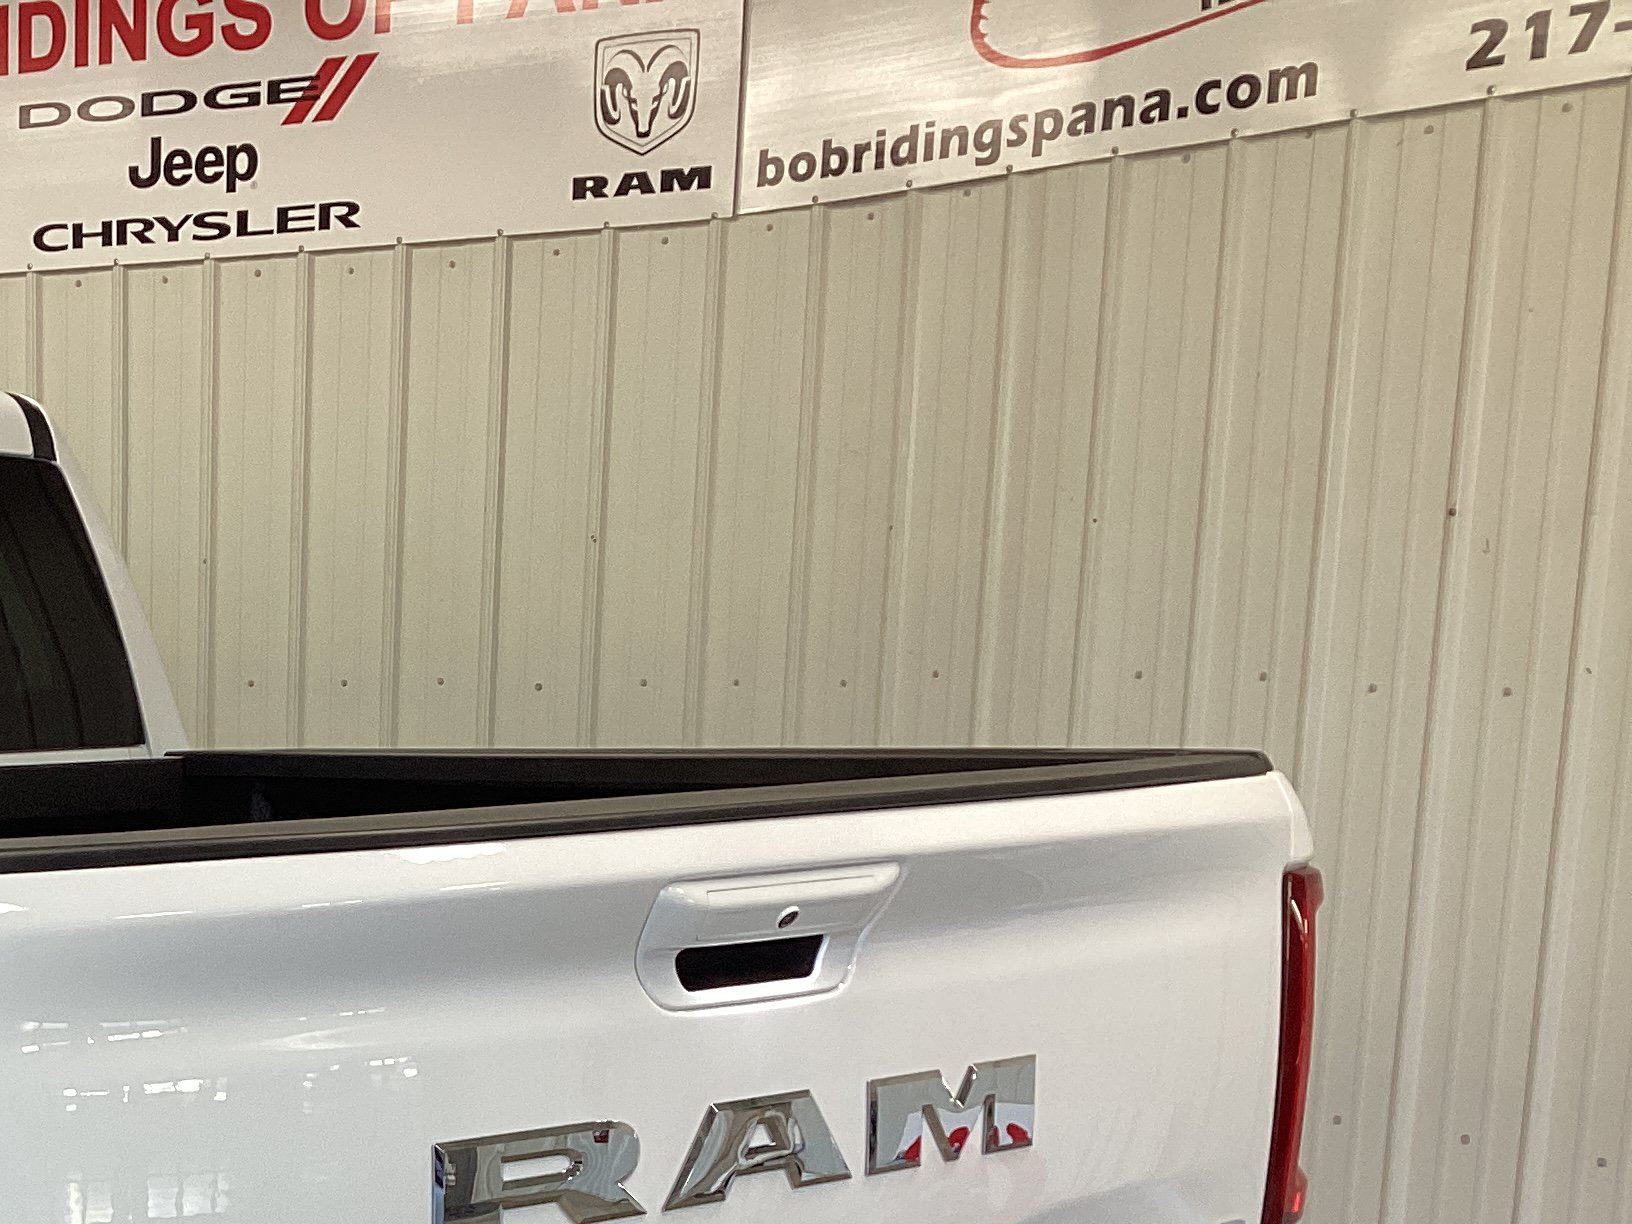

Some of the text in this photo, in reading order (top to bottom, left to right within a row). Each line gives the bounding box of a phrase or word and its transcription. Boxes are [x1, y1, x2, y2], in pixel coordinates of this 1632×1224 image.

[18, 75, 323, 130] DODGE
[755, 60, 1319, 189] bobridingspana.com
[128, 136, 258, 193] Jeep
[571, 165, 713, 201] RAM
[32, 201, 361, 253] CHRYSLER
